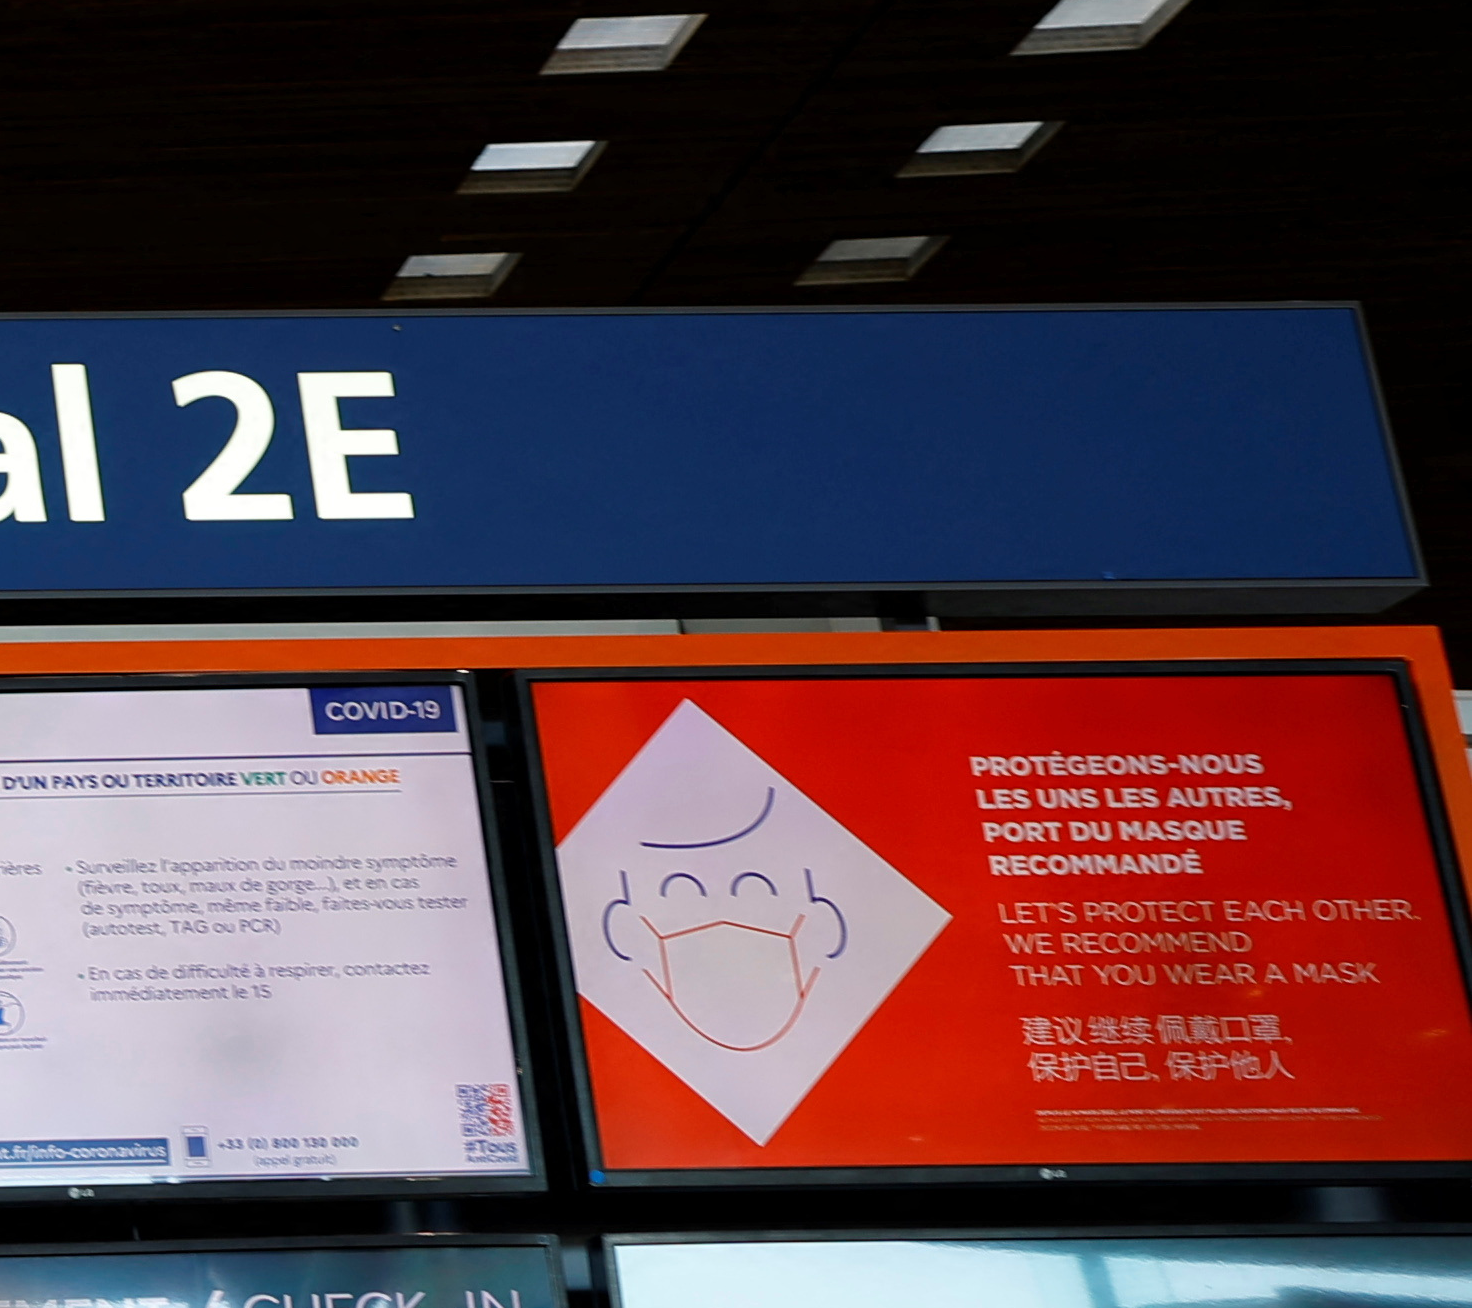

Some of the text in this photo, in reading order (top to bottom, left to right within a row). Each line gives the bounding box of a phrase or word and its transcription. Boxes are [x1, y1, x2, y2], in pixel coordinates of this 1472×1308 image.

[171, 369, 415, 523] 2E
[324, 699, 442, 722] COVID-19
[970, 750, 1264, 777] PROTÉGEONS-NOUS
[2, 776, 48, 792] D'UN
[52, 773, 100, 791] PAYS
[100, 773, 130, 790] OU
[130, 770, 240, 788] TERRITOIRE
[238, 770, 288, 787] VERT
[290, 768, 319, 786] OU
[319, 768, 401, 786] ORANGE
[974, 785, 1293, 811] LES UNS LES AUTRES,
[981, 818, 1249, 844] PORT DU MASQUE
[75, 851, 459, 878] Surveillez l'apparition du moindre symptôme
[988, 847, 1205, 876] RECOMMANDÉ
[997, 898, 1420, 925] LET'S PROTECT EACH OTHER.
[1003, 930, 1252, 955] WE RECOMMEND
[87, 961, 432, 982] En cas de difficulté à respirer, contactez
[1008, 961, 1380, 987] THAT YOU WEAR A MASK
[89, 983, 273, 1002] immédiatement le 15
[271, 1136, 301, 1150] 800
[301, 1136, 330, 1150] 130
[330, 1135, 360, 1149] 000
